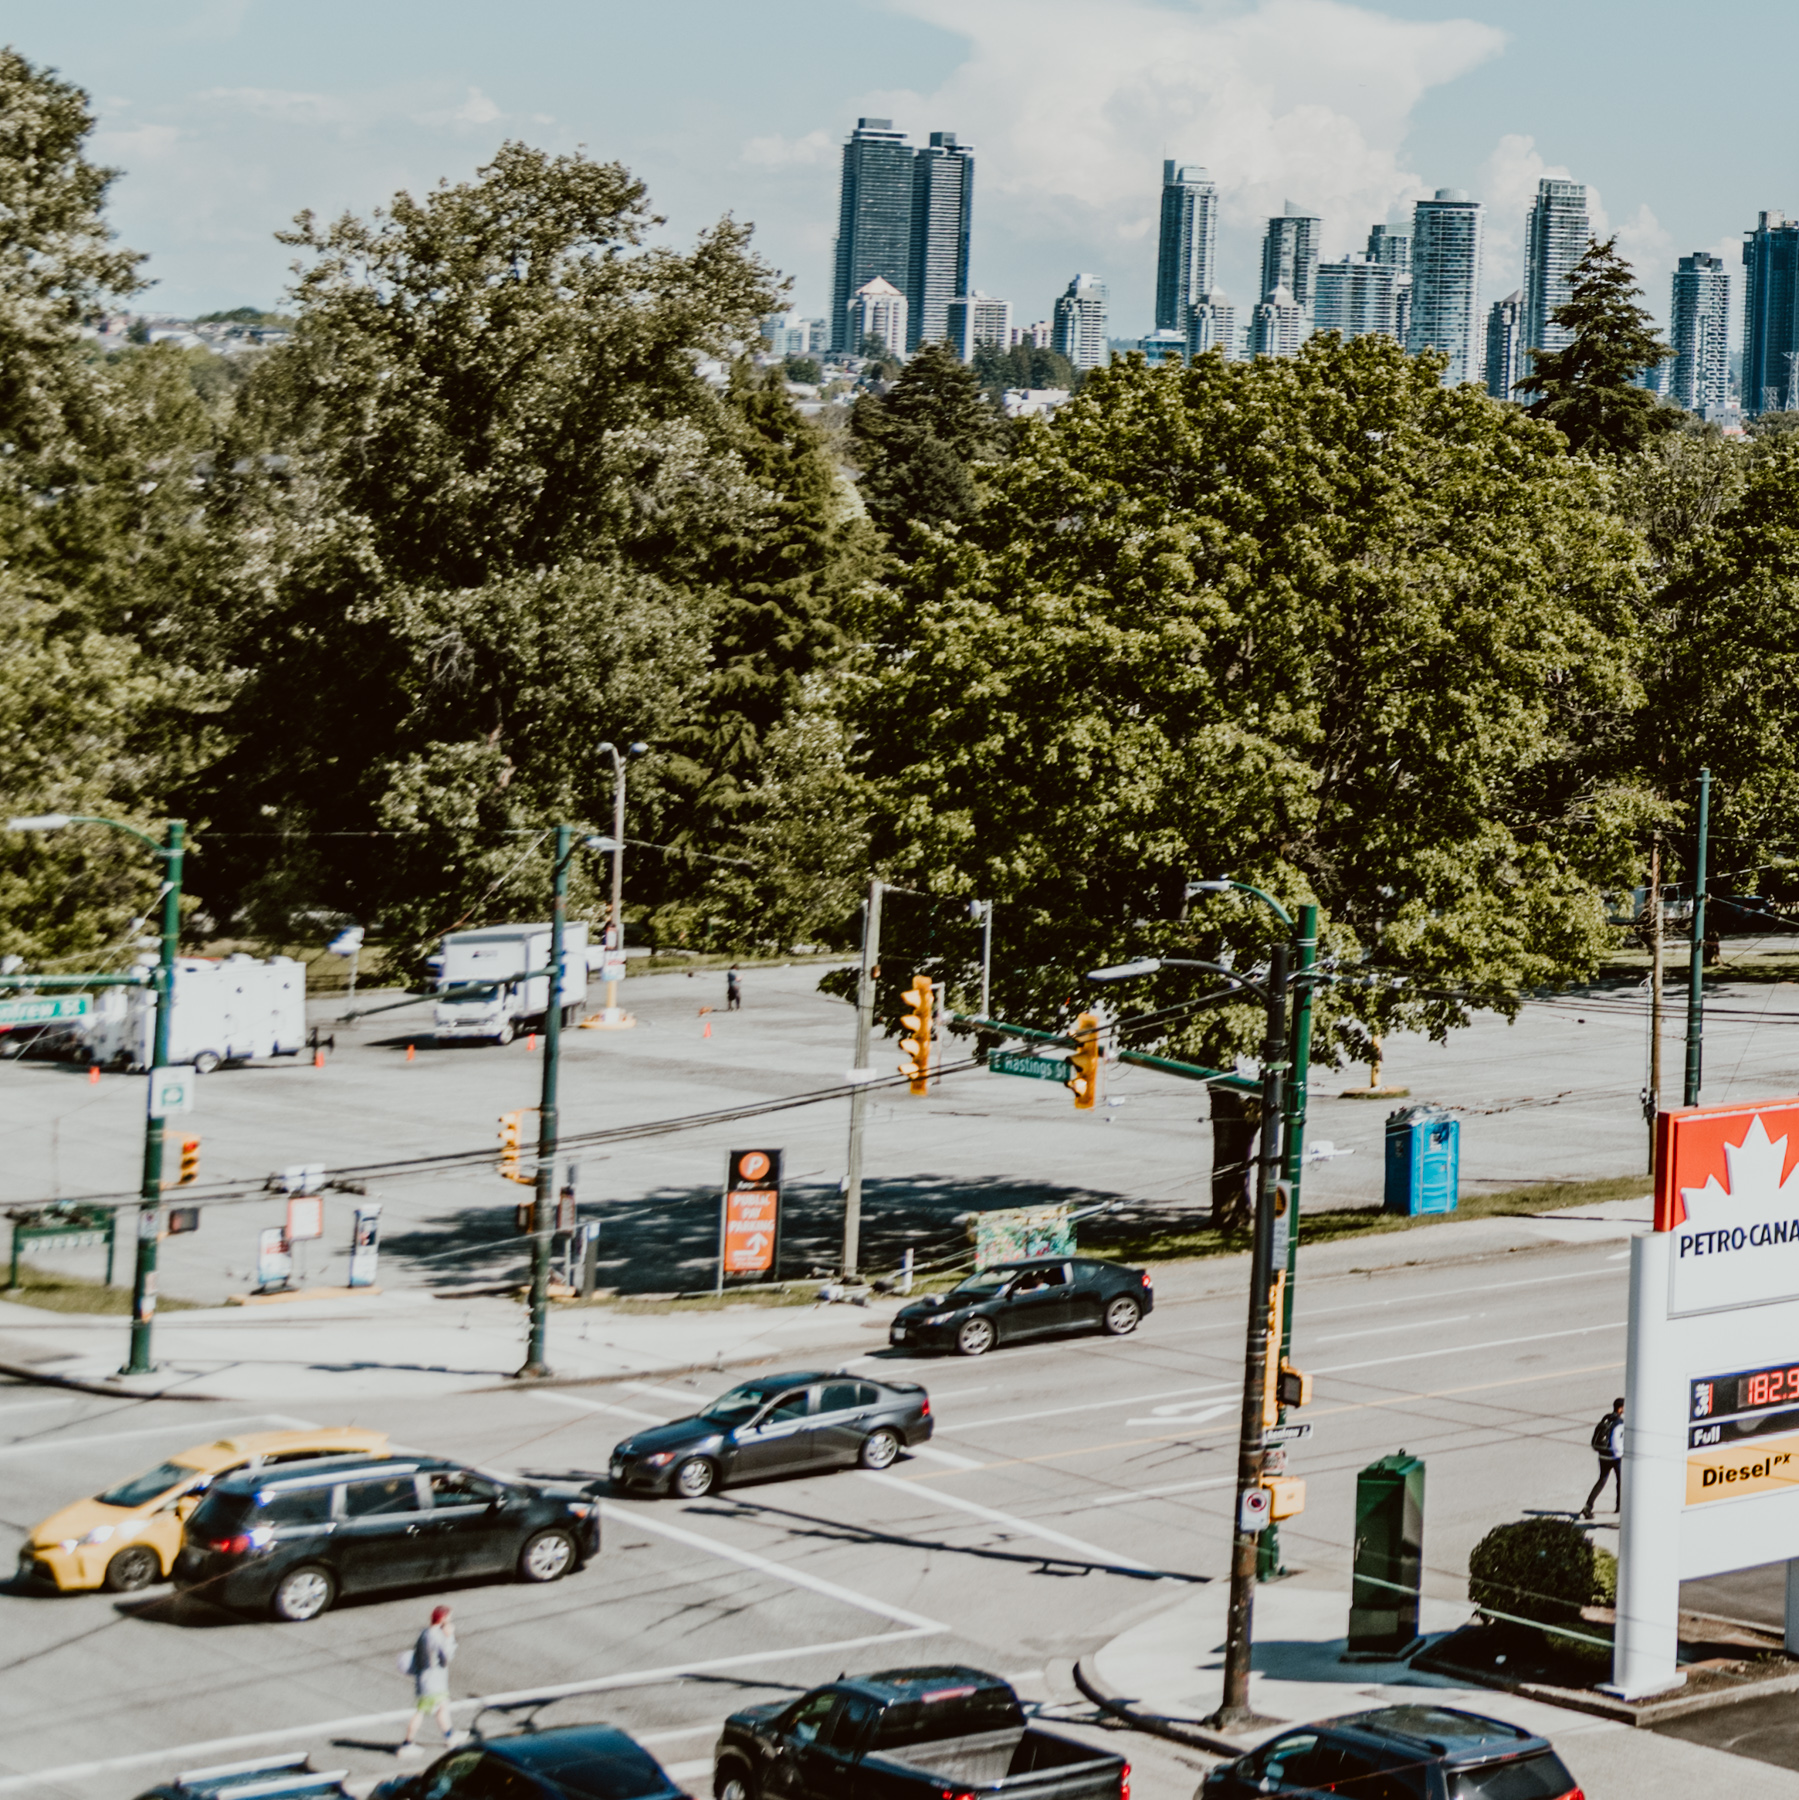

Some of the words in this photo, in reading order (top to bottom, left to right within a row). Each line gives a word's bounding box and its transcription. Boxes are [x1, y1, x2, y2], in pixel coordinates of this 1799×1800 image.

[1005, 1055, 1052, 1080] Hastings
[729, 1219, 775, 1234] PARKING
[1694, 1425, 1721, 1446] Full
[1702, 1458, 1771, 1487] Diesel
